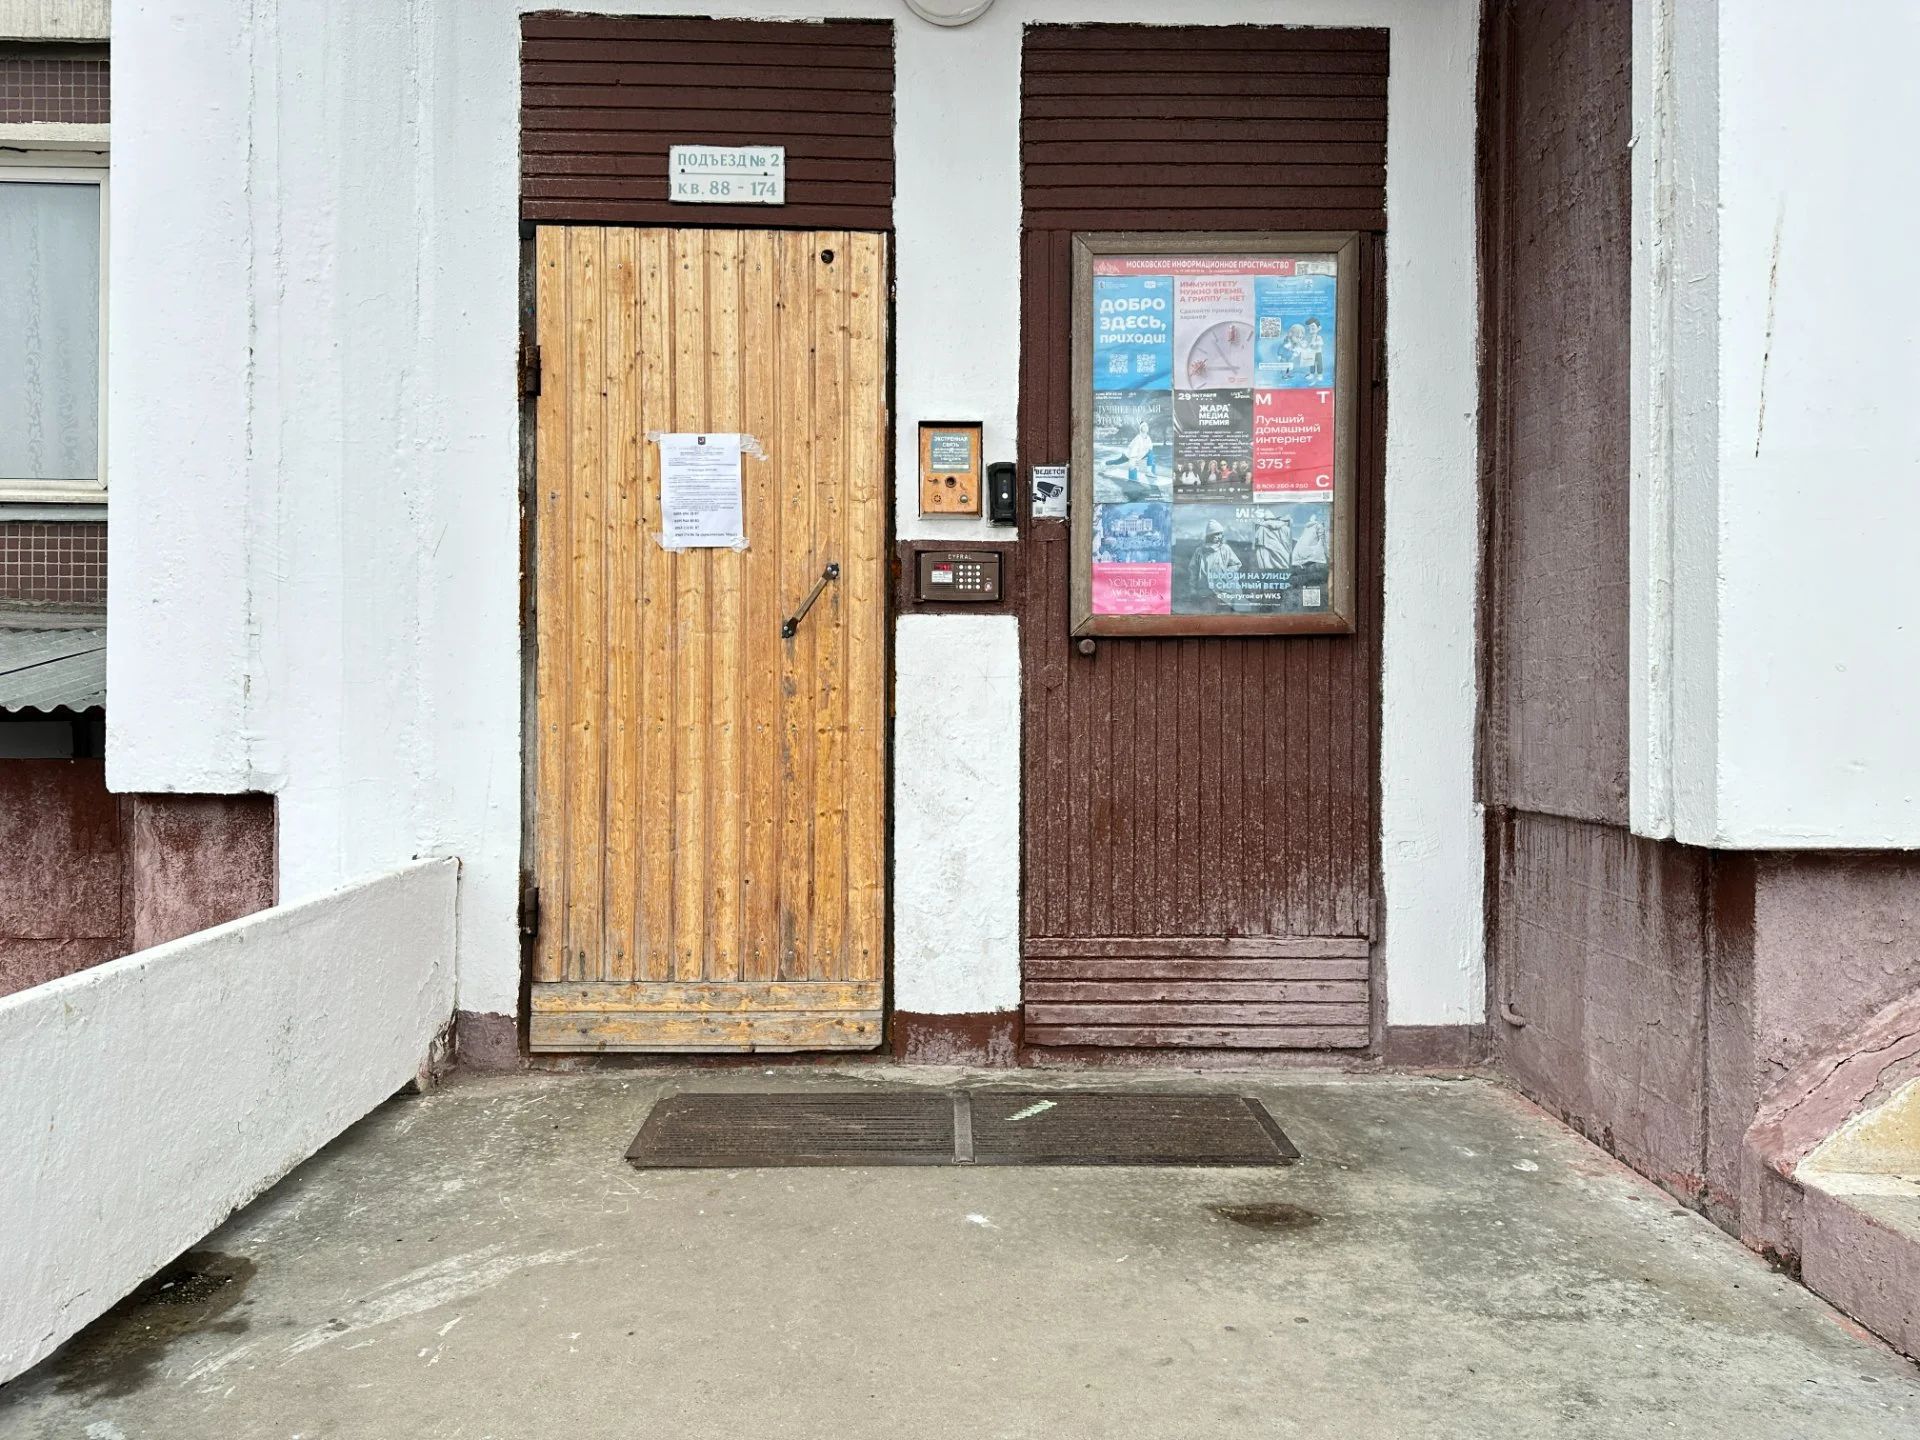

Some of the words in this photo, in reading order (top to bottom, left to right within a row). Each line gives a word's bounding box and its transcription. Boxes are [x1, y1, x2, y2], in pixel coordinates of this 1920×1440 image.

[677, 153, 747, 168] ПОДЪЕЗД
[749, 154, 766, 167] №
[770, 153, 780, 167] 2
[709, 180, 731, 196] 88
[751, 181, 777, 196] 174
[1126, 261, 1171, 270] МОСКОВСКОЕ
[1171, 260, 1237, 270] ИНФОРМАЦИОННОЕ
[1238, 261, 1290, 270] ПРОСТРАНСТВО
[1179, 295, 1186, 303] А
[1229, 294, 1246, 302] НЕТ
[1099, 298, 1166, 314] ДОБРО
[1099, 315, 1167, 332] ЗДЕСЬ,
[1099, 333, 1166, 345] ПРИХОДИ!
[1177, 393, 1191, 401] 29
[1199, 404, 1229, 412] ЖАРА
[1199, 412, 1229, 420] МЕДИА
[1255, 414, 1305, 426] Лучший
[1255, 423, 1322, 435] домашний
[1255, 435, 1313, 446] интернет
[1256, 458, 1284, 469] 375
[1247, 572, 1260, 580] НА
[1261, 572, 1292, 581] УЛИЦУ
[1215, 581, 1262, 590] СИЛЬНЫЙ
[1263, 582, 1291, 590] ВЕТЕР
